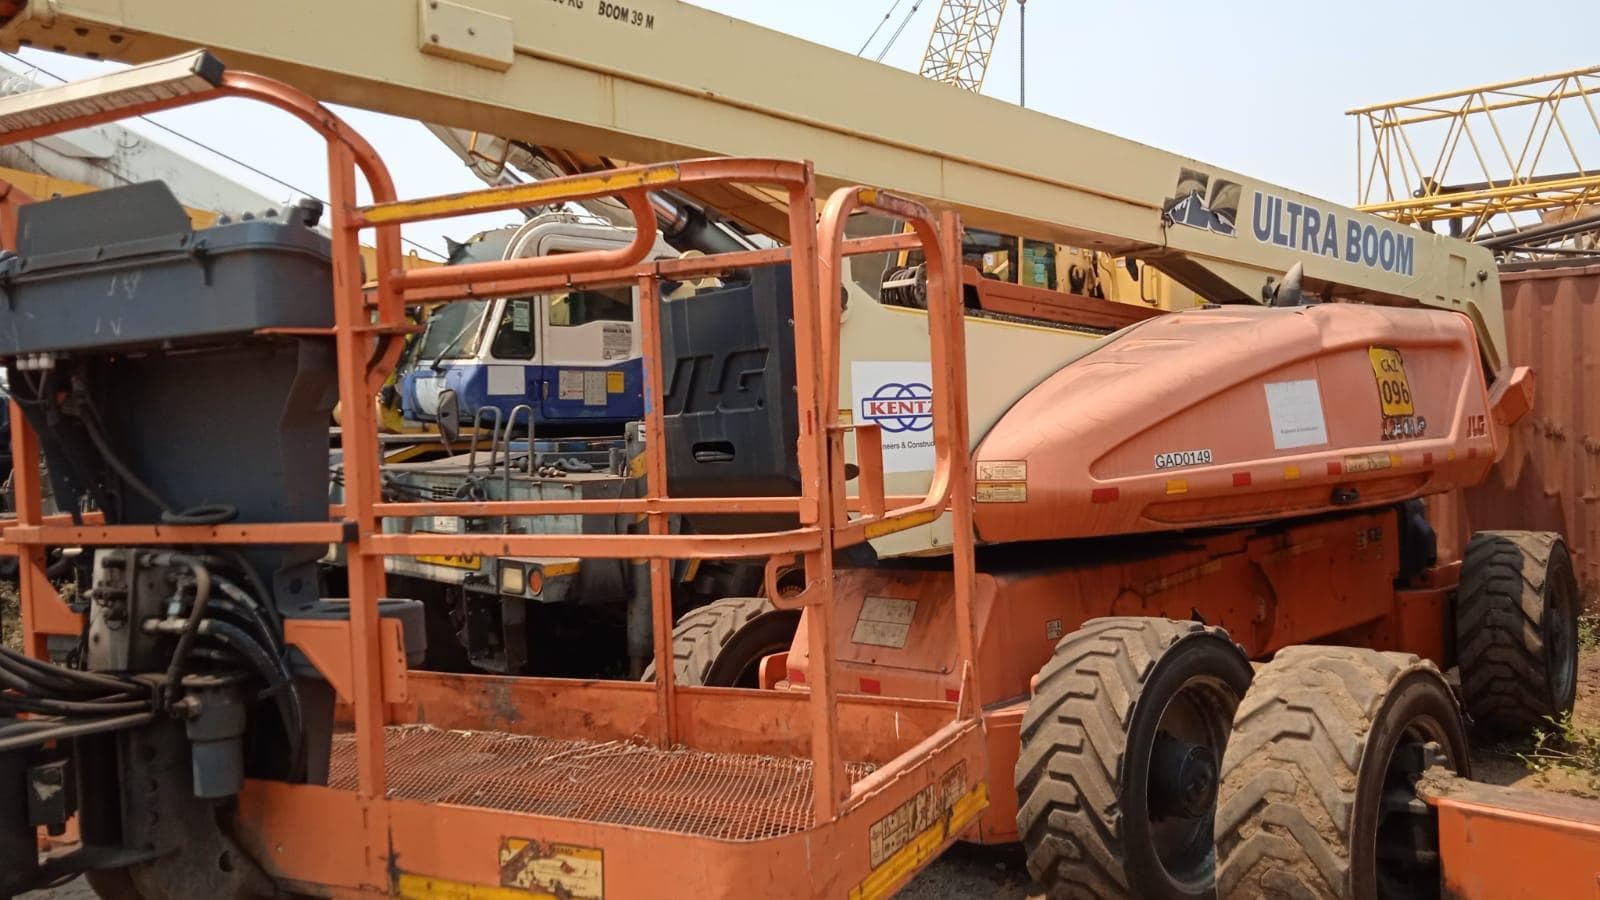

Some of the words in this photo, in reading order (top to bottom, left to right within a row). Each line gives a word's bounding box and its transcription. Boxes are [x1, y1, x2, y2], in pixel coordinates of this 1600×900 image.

[598, 1, 628, 22] BOOM
[631, 10, 644, 26] 39
[645, 15, 655, 30] M
[1252, 191, 1339, 259] ULTRA
[1344, 217, 1415, 276] BOOM
[1382, 380, 1410, 405] 096
[907, 440, 936, 449] Construc
[1155, 450, 1211, 468] GAD0149
